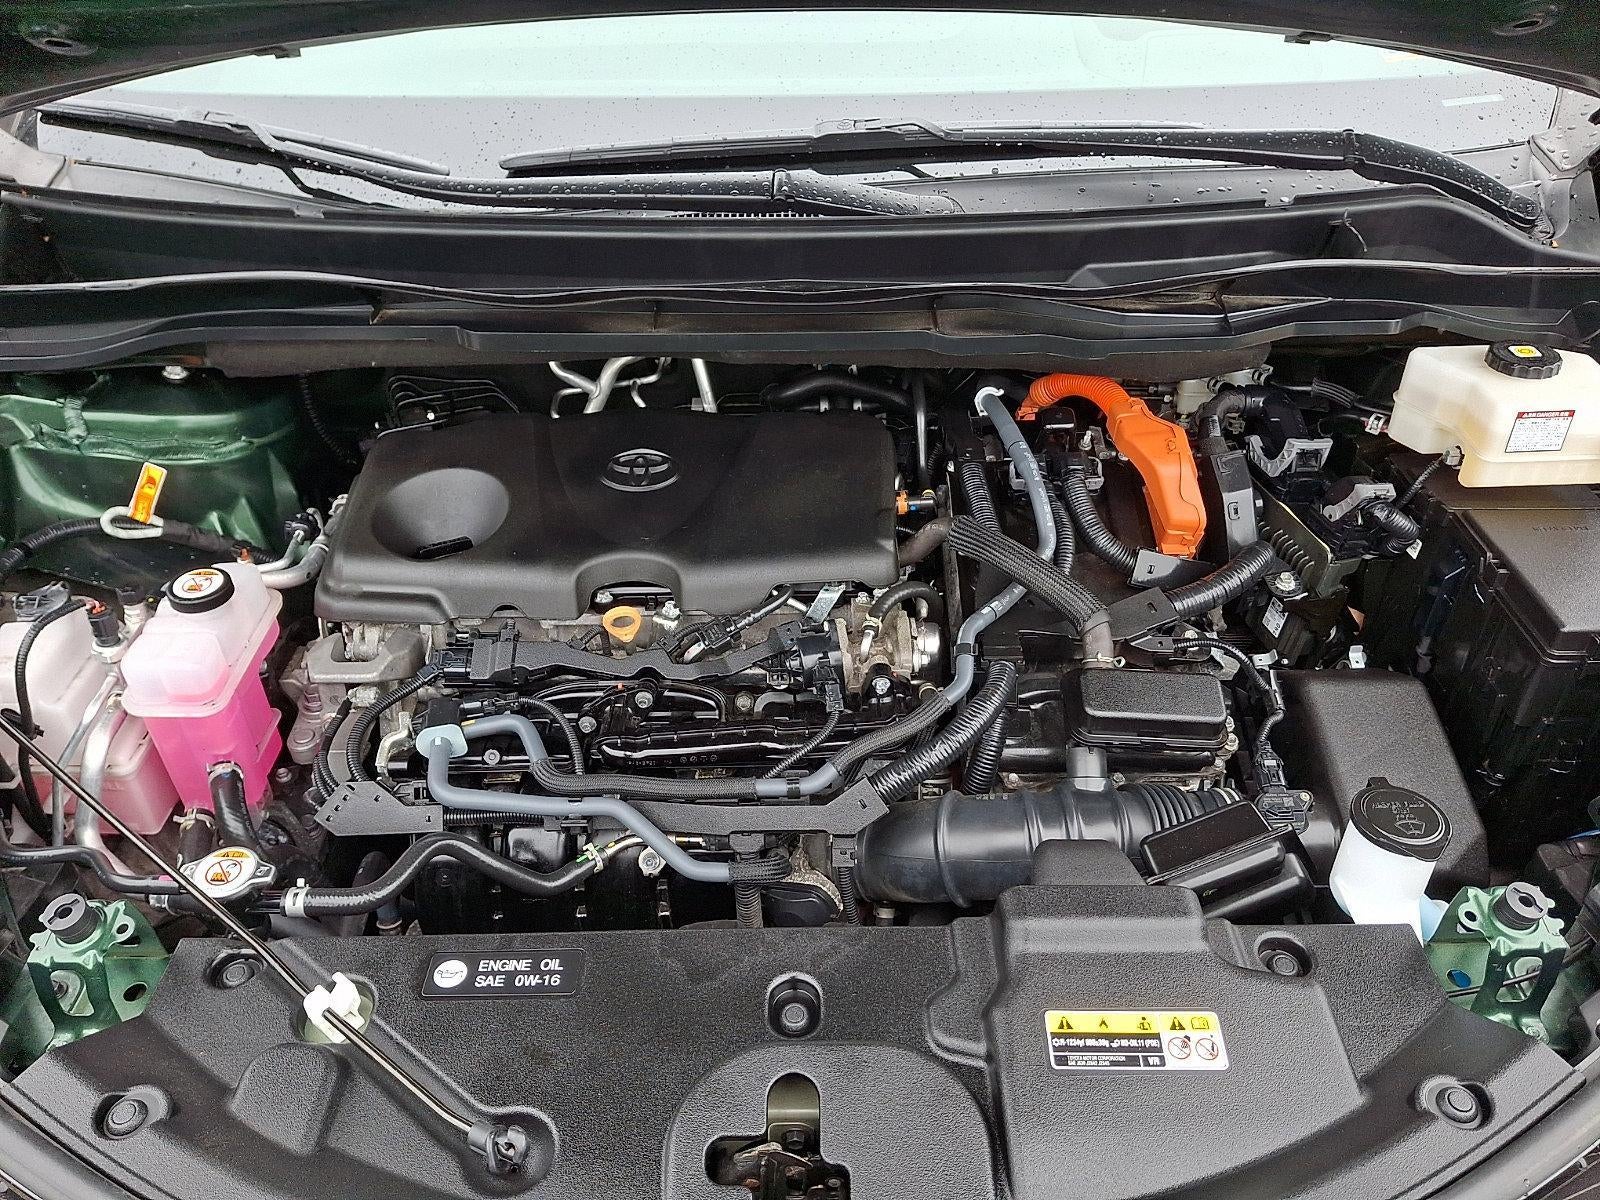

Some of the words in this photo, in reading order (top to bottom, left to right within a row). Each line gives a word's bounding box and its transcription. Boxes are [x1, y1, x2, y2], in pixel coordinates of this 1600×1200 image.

[478, 959, 532, 971] ENGINE
[540, 958, 564, 971] OIL
[474, 975, 505, 987] SAE
[514, 974, 561, 987] 0W-16
